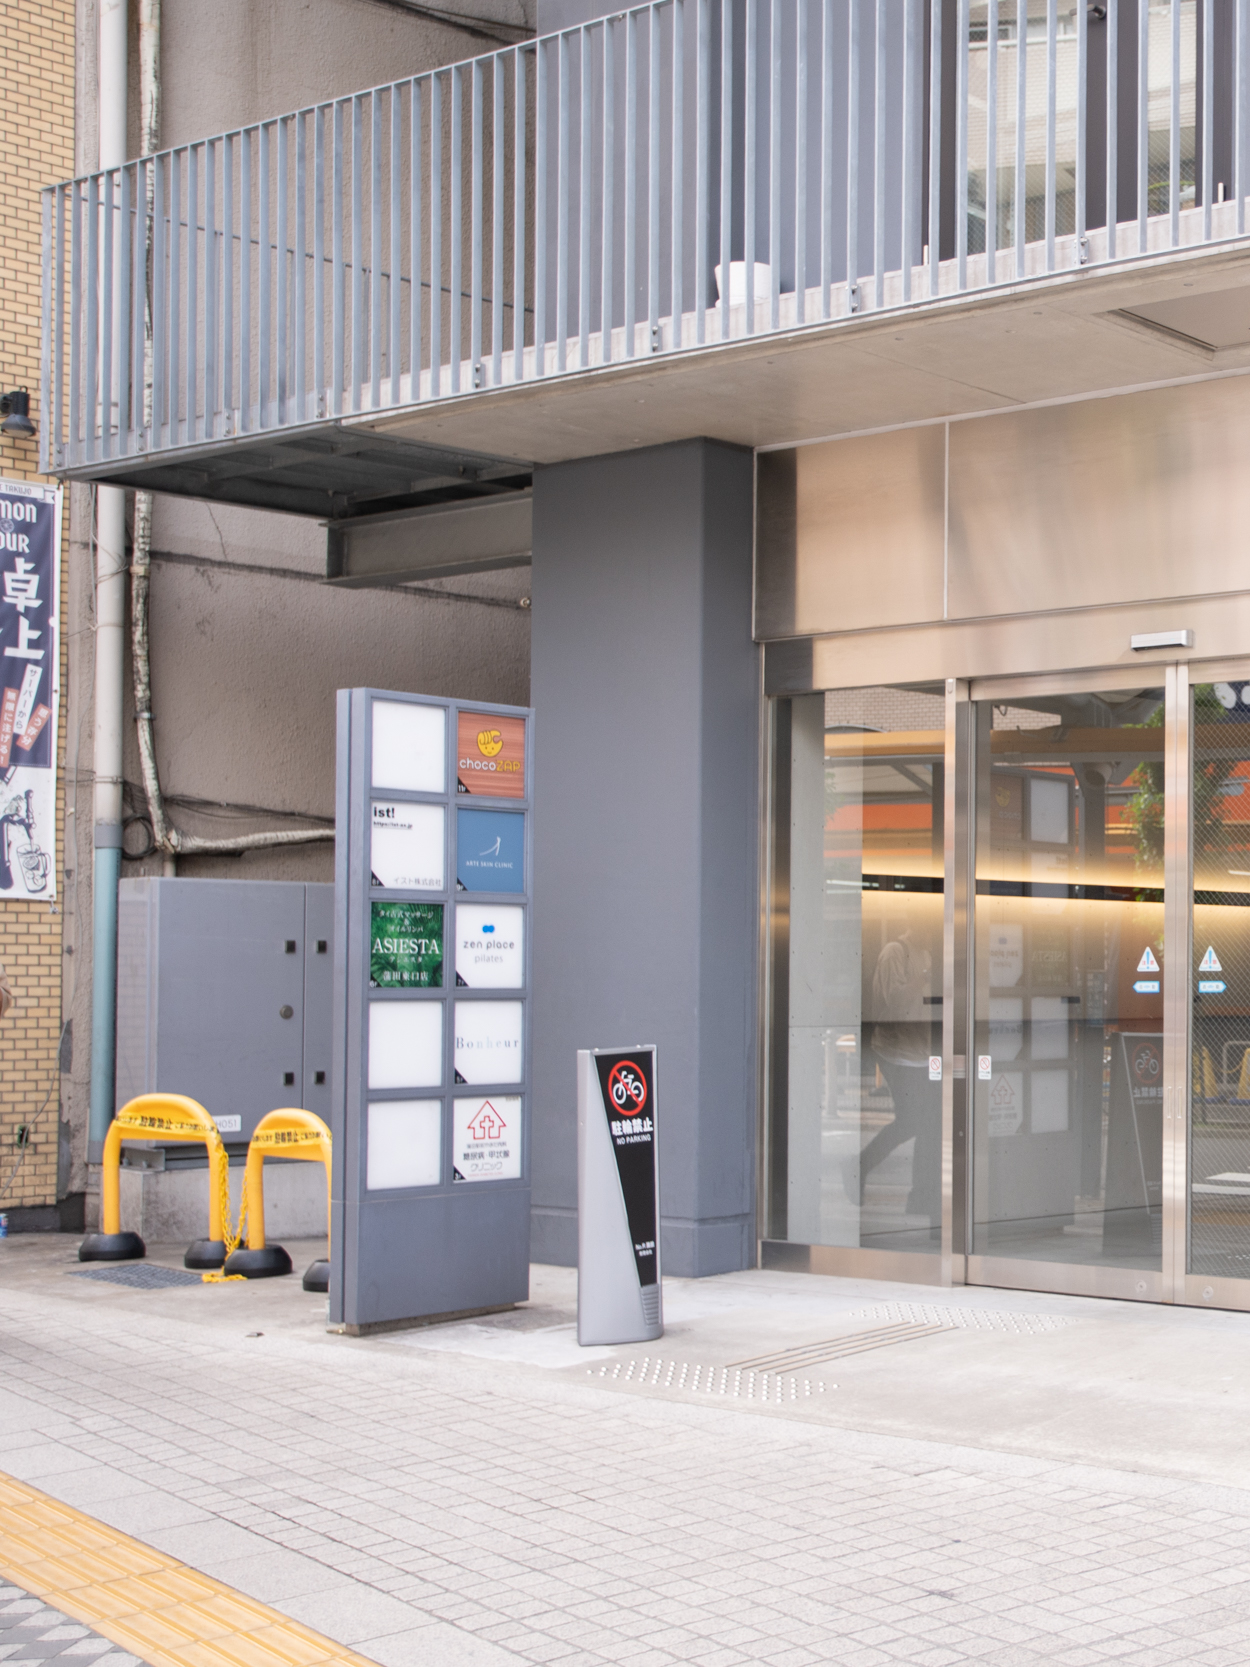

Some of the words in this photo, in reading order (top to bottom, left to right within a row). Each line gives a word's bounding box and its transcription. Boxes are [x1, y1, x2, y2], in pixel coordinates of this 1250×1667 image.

[5, 484, 32, 496] TAKUJO
[3, 556, 45, 661] 卓上
[15, 667, 39, 730] サーバーから
[459, 757, 521, 772] chocoZAP
[373, 806, 395, 819] ist!
[465, 860, 479, 868] ARTE
[394, 877, 442, 887] イスト株式会社
[372, 937, 440, 954] ASIESTA
[463, 940, 483, 949] zen
[486, 939, 515, 951] place
[474, 954, 504, 964] pilates
[456, 1036, 519, 1050] Bonheur
[611, 1116, 654, 1136] 駐輪禁止
[616, 1136, 626, 1146] NO
[625, 1133, 652, 1144] PARKING
[470, 1161, 503, 1172] クリニック
